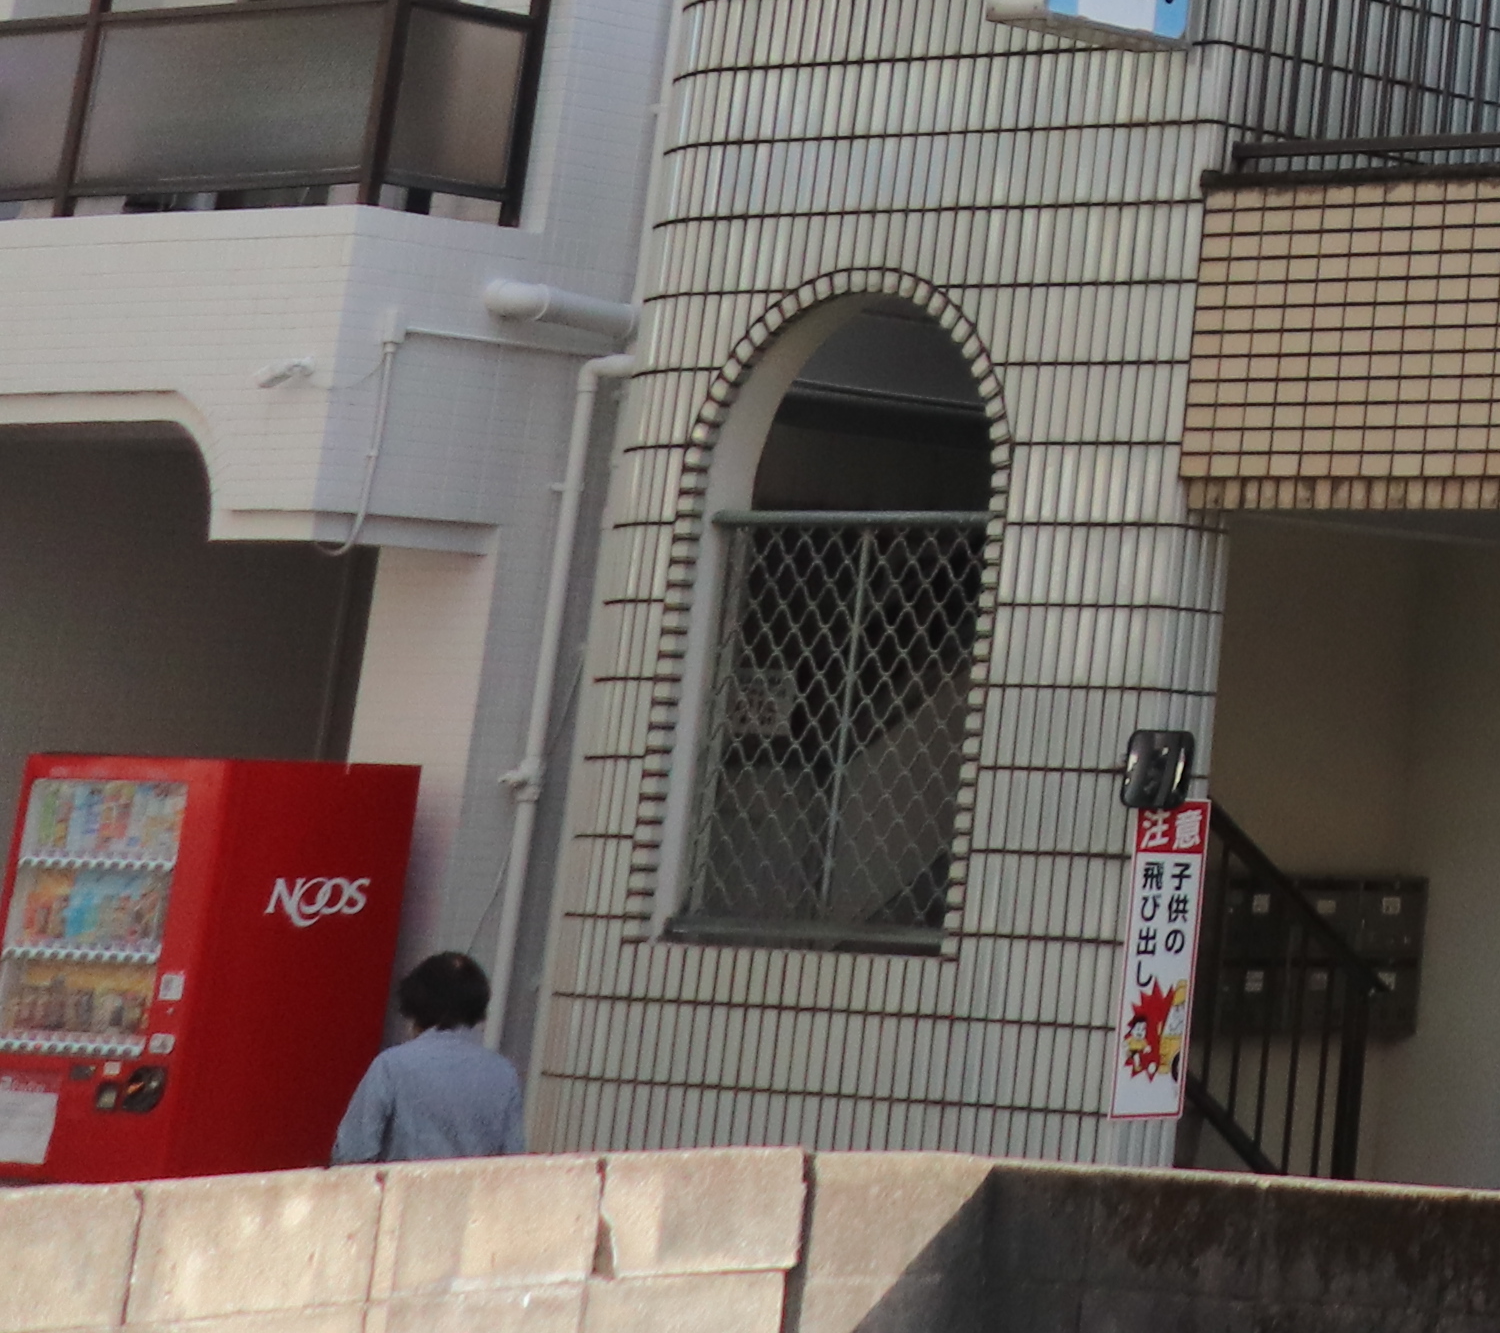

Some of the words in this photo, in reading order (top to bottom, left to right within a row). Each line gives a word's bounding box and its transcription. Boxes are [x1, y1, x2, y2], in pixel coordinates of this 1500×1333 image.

[1140, 808, 1203, 851] 注意
[1135, 860, 1165, 989] 飛び出し
[1164, 861, 1193, 955] 子供の
